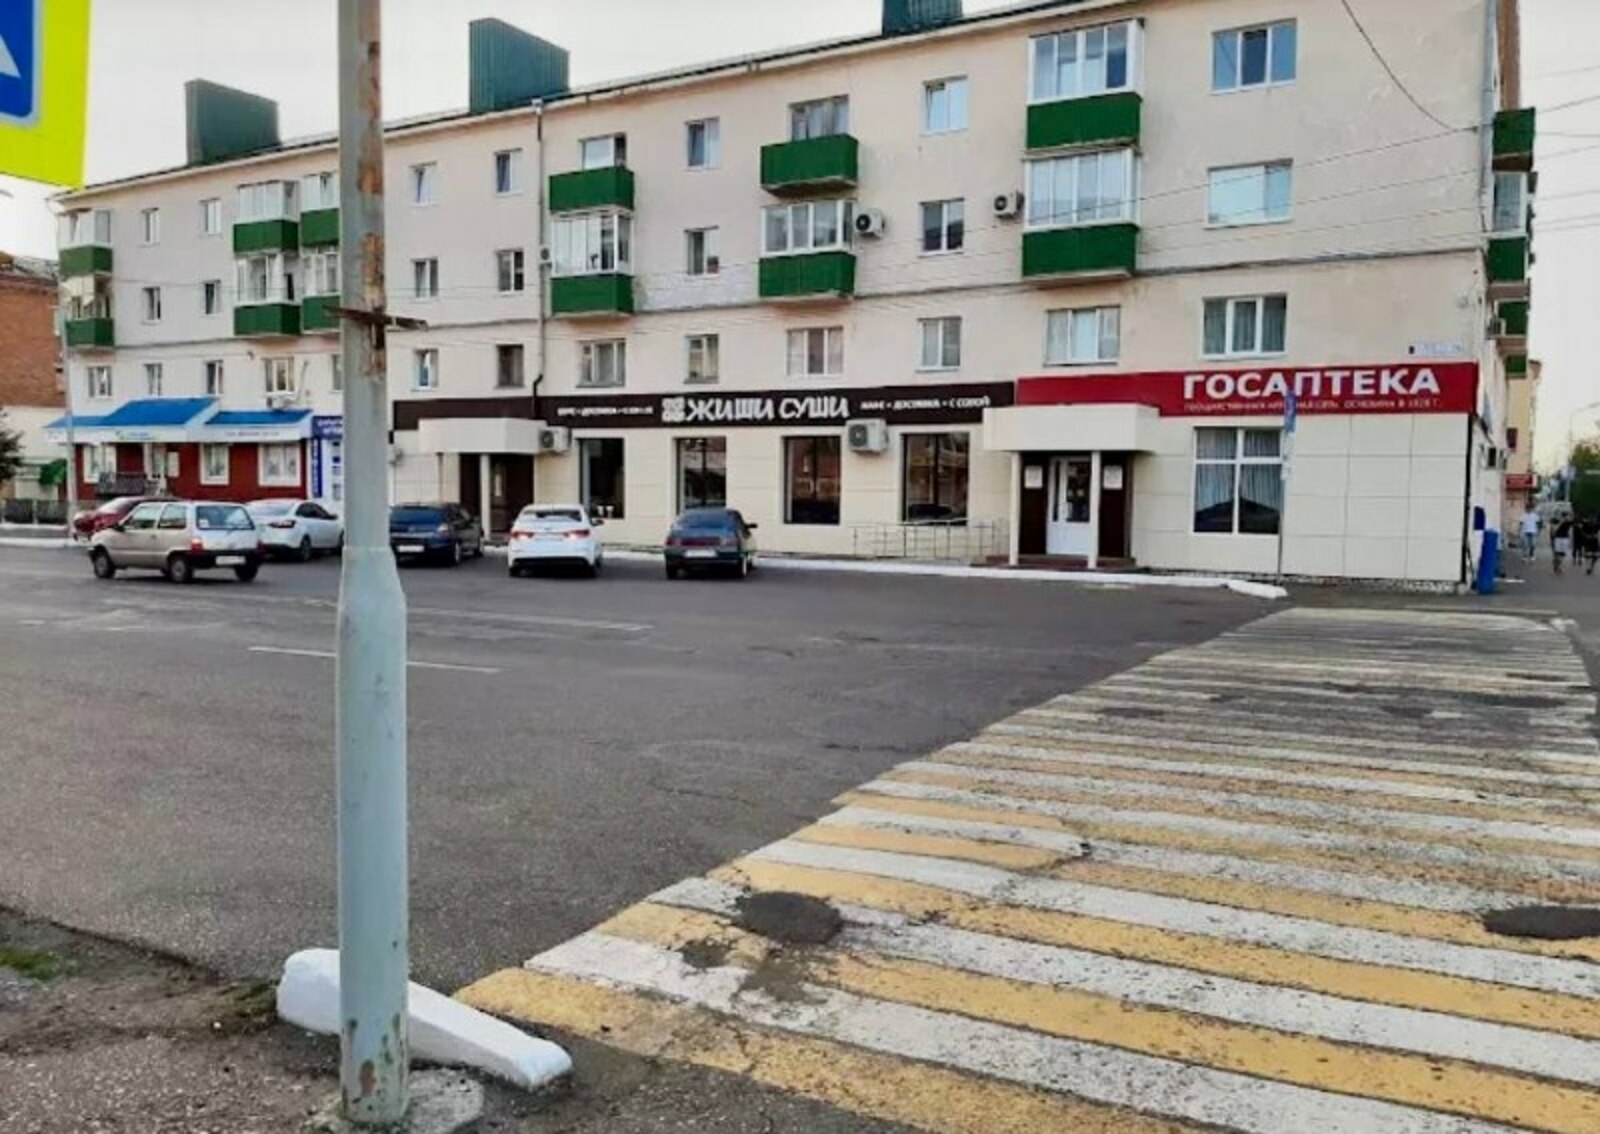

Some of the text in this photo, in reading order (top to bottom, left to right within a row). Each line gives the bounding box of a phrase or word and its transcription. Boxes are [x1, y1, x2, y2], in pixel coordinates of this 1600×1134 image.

[1183, 367, 1440, 400] ГОСАПТЕКА
[686, 395, 850, 422] ЖИШИ СУШИ
